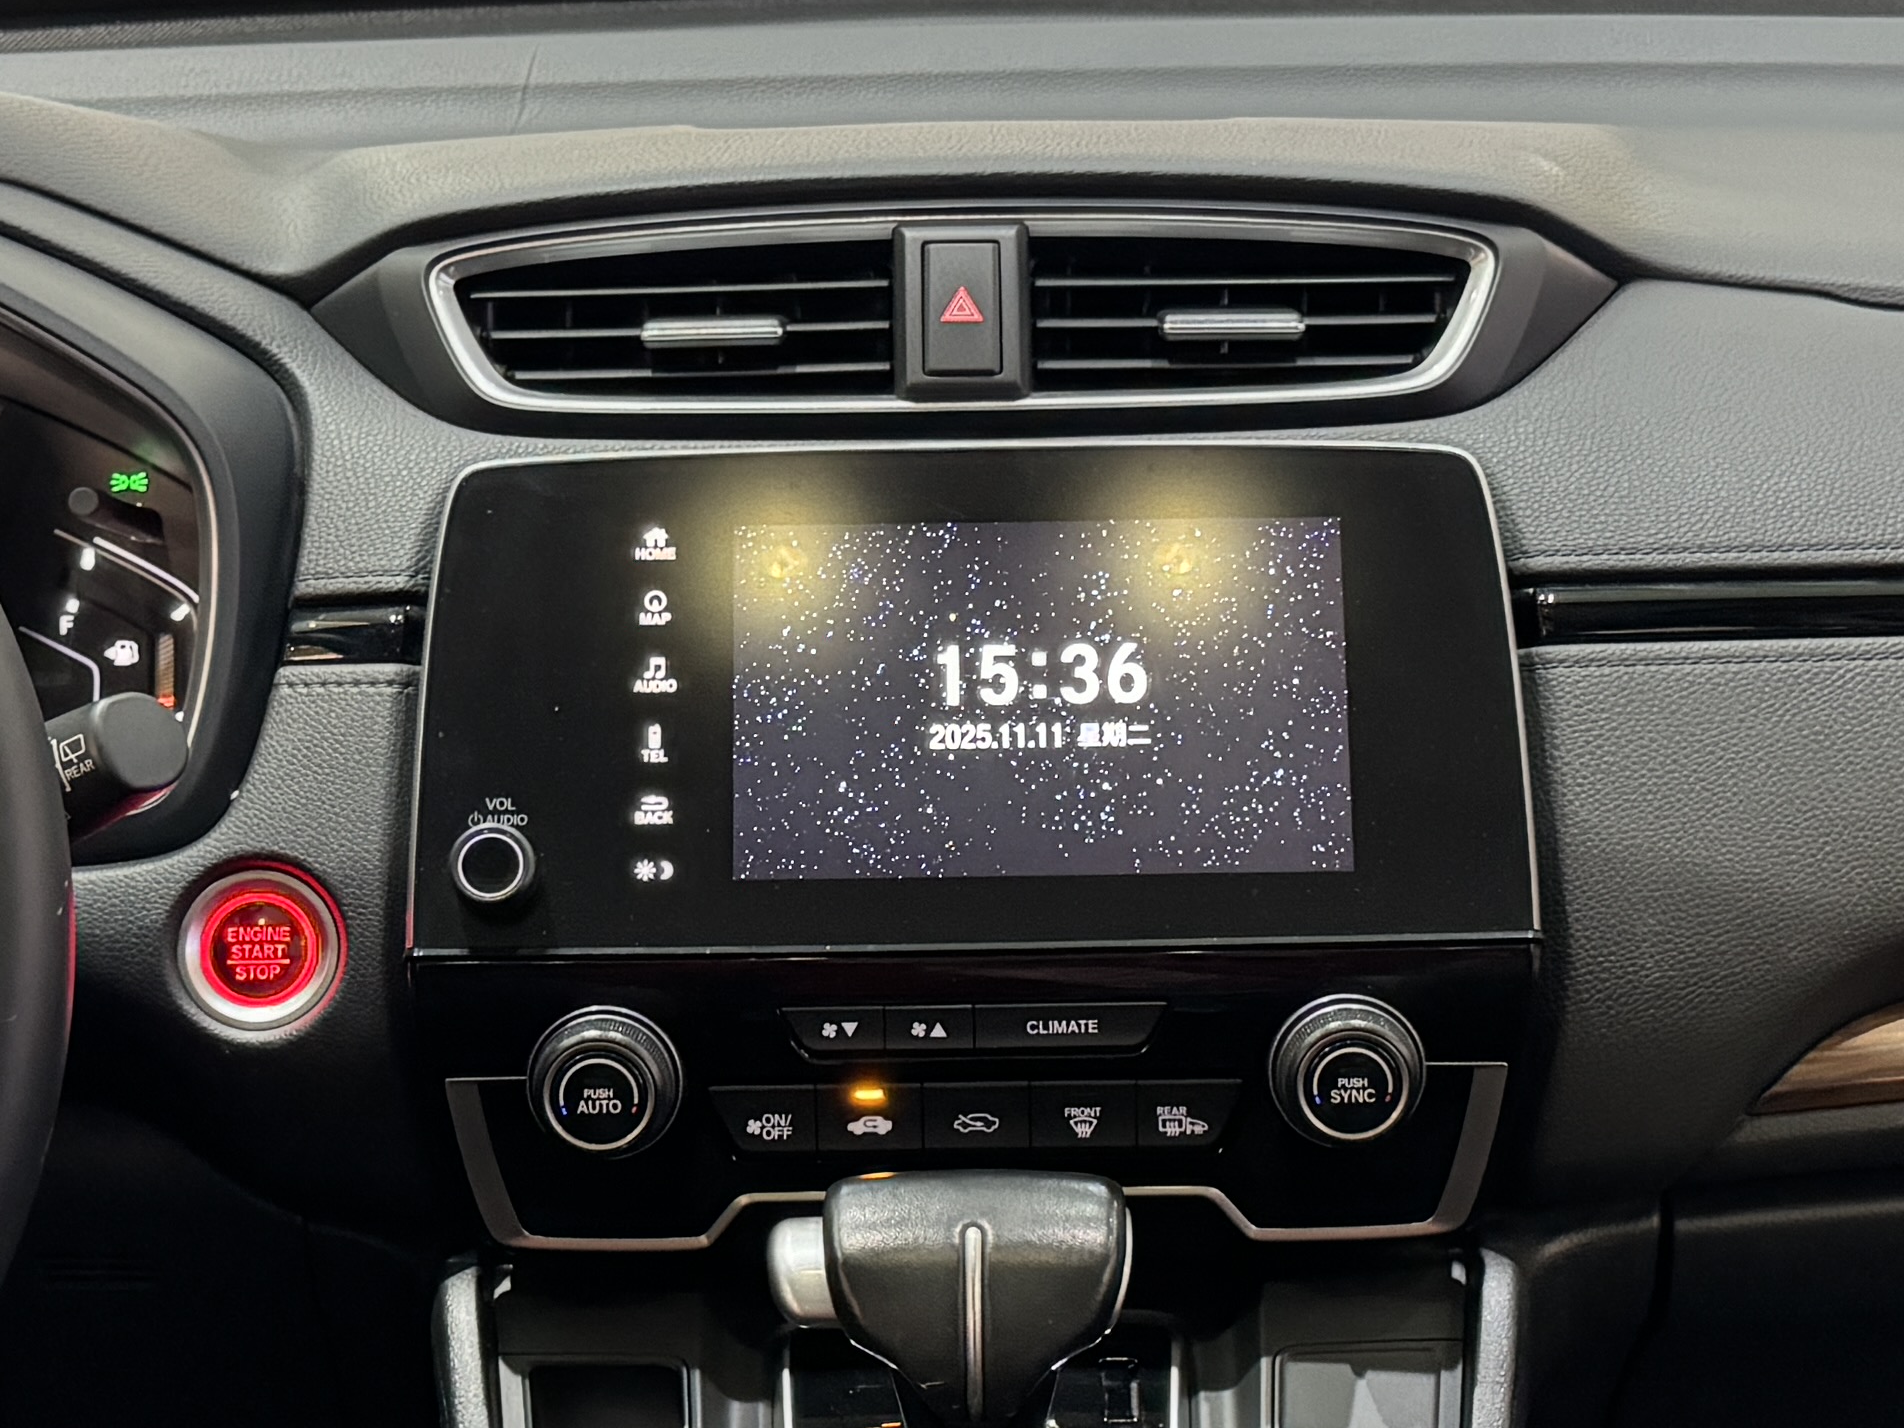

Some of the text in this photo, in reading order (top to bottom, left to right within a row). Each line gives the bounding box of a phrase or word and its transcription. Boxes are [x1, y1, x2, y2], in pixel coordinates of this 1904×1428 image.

[634, 546, 677, 561] HOME
[59, 615, 75, 635] F
[638, 611, 673, 626] MAP
[936, 641, 1148, 707] 15:36
[633, 678, 679, 694] AUDIO
[928, 722, 1152, 750] 2025.11.11 星期二
[640, 748, 669, 763] TEL
[485, 797, 516, 811] VOL
[485, 814, 528, 827] AUDIO
[633, 810, 674, 825] BACK
[227, 926, 291, 943] ENGINE
[230, 943, 286, 960] START
[235, 964, 281, 981] STOP
[1025, 1019, 1099, 1035] CLIMATE
[1337, 1077, 1368, 1089] PUSH
[583, 1088, 614, 1099] PUSH
[1330, 1088, 1377, 1105] SYNC
[576, 1099, 622, 1115] AUTO
[1064, 1106, 1102, 1118] FRONT
[1156, 1105, 1188, 1117] REAR
[762, 1126, 793, 1141] OFF
